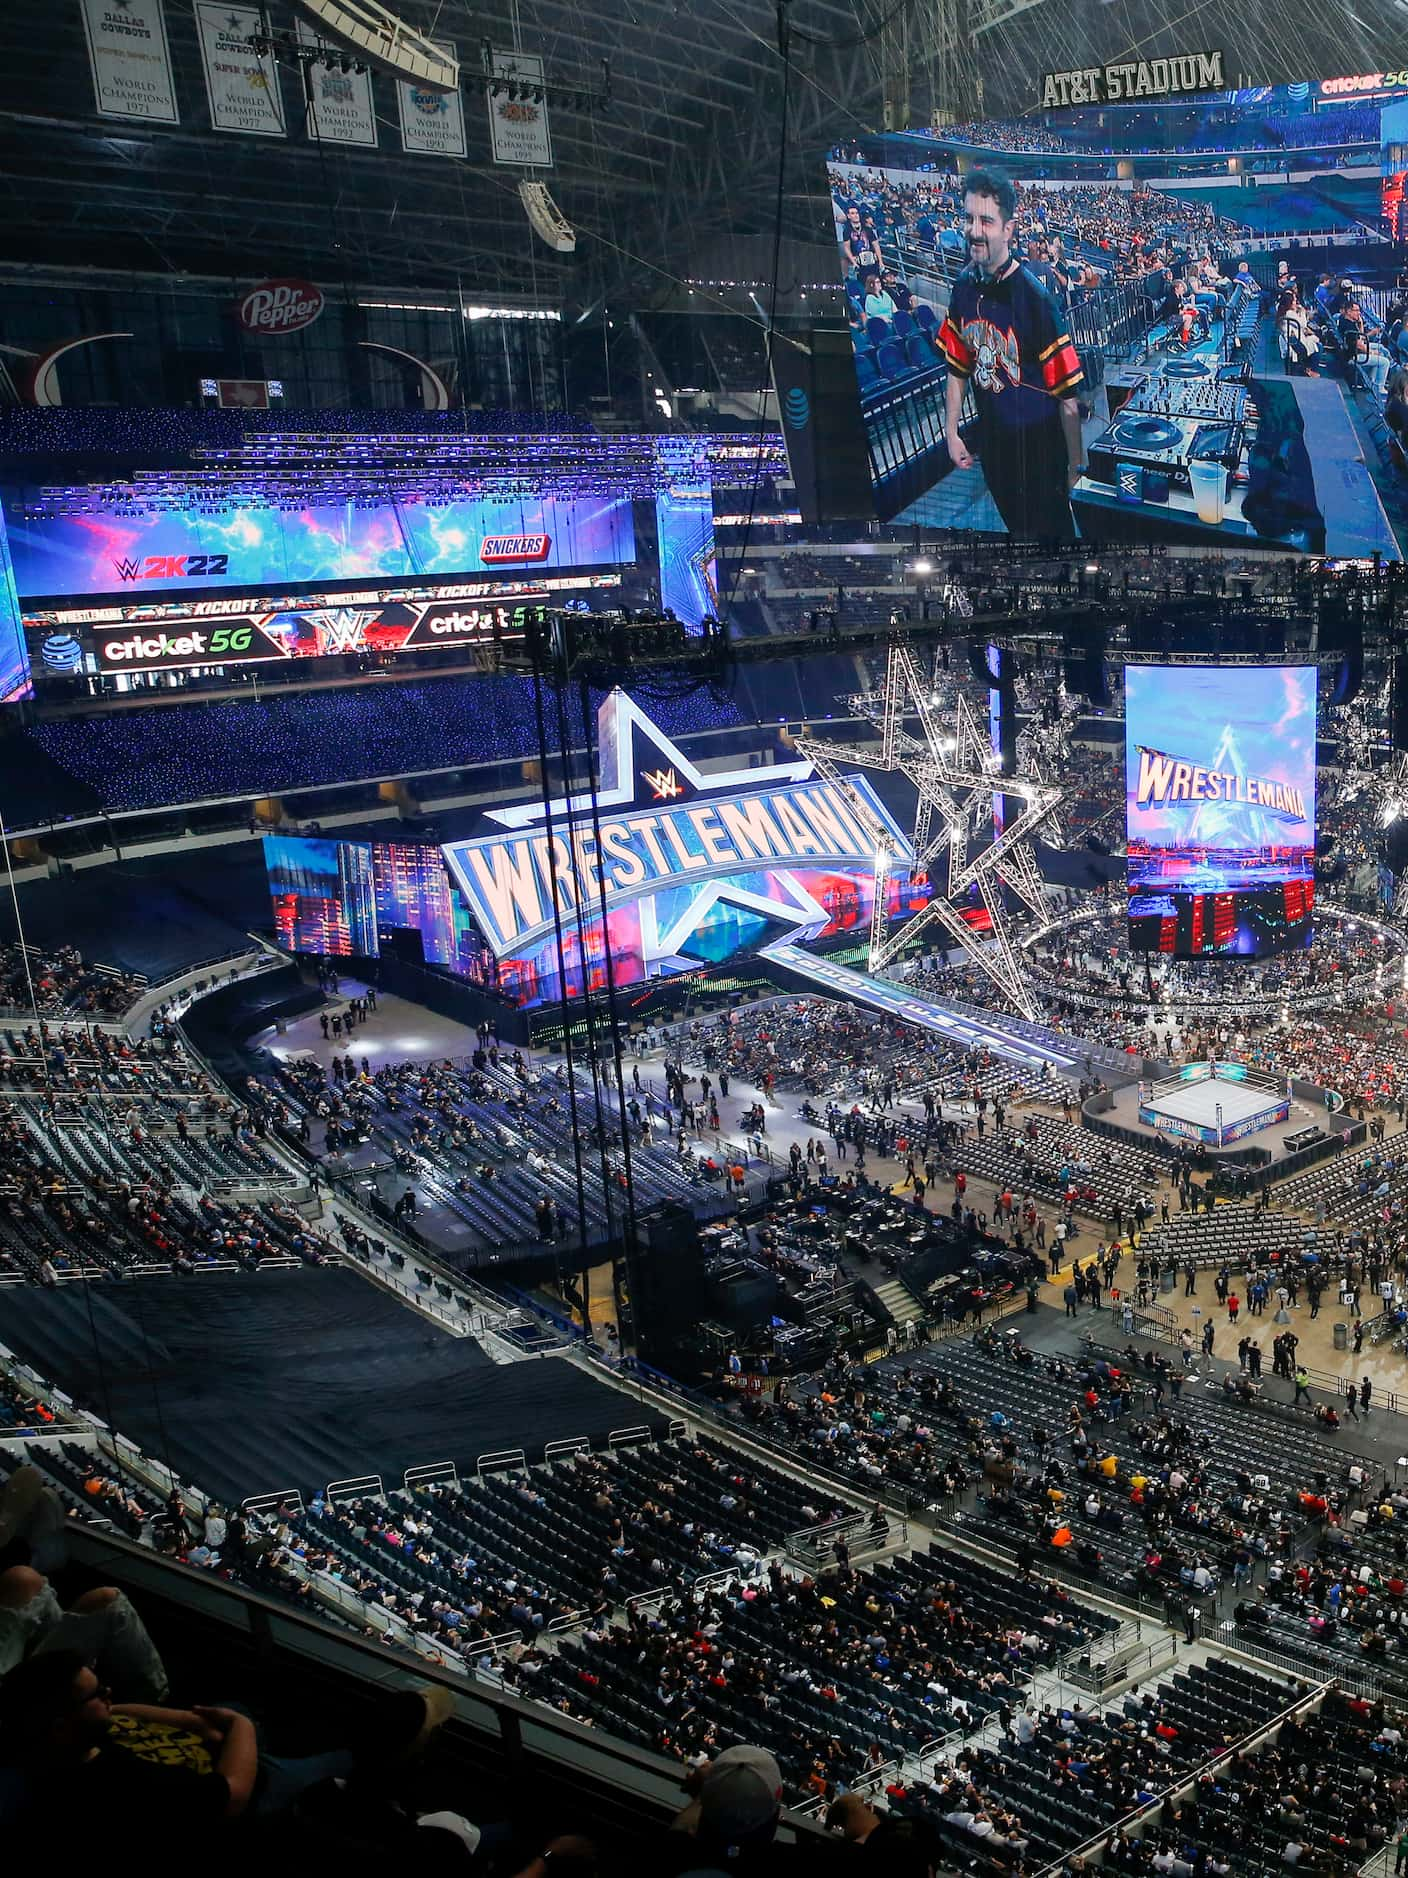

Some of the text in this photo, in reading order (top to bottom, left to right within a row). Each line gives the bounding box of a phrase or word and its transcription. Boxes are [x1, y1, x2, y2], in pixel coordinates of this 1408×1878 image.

[104, 13, 145, 27] DALLAS
[101, 23, 151, 39] COWBOYS
[214, 62, 241, 74] SUPER
[113, 76, 156, 91] WORLD
[1043, 51, 1223, 107] AT&T STADIUM
[1321, 74, 1384, 93] cricket
[102, 88, 170, 105] CHAMPIONS
[226, 93, 265, 106] WORLD
[126, 103, 151, 113] 1971
[322, 105, 359, 118] WORLD
[416, 118, 449, 129] WORLD
[407, 127, 460, 141] CHAMPIONS
[507, 130, 537, 141] WORLD
[497, 140, 546, 152] CHAMPIONS
[273, 287, 303, 308] Dr
[249, 290, 319, 328] Pepper
[485, 536, 543, 556] SNICKERS
[143, 554, 229, 579] 2K22
[436, 582, 494, 599] KICKOFF
[194, 598, 259, 616] KICKOFF
[105, 628, 252, 661] cricket 5G
[1137, 751, 1306, 820] WRESTLEMANIA
[1154, 1115, 1201, 1138] WRESTLEMANIA
